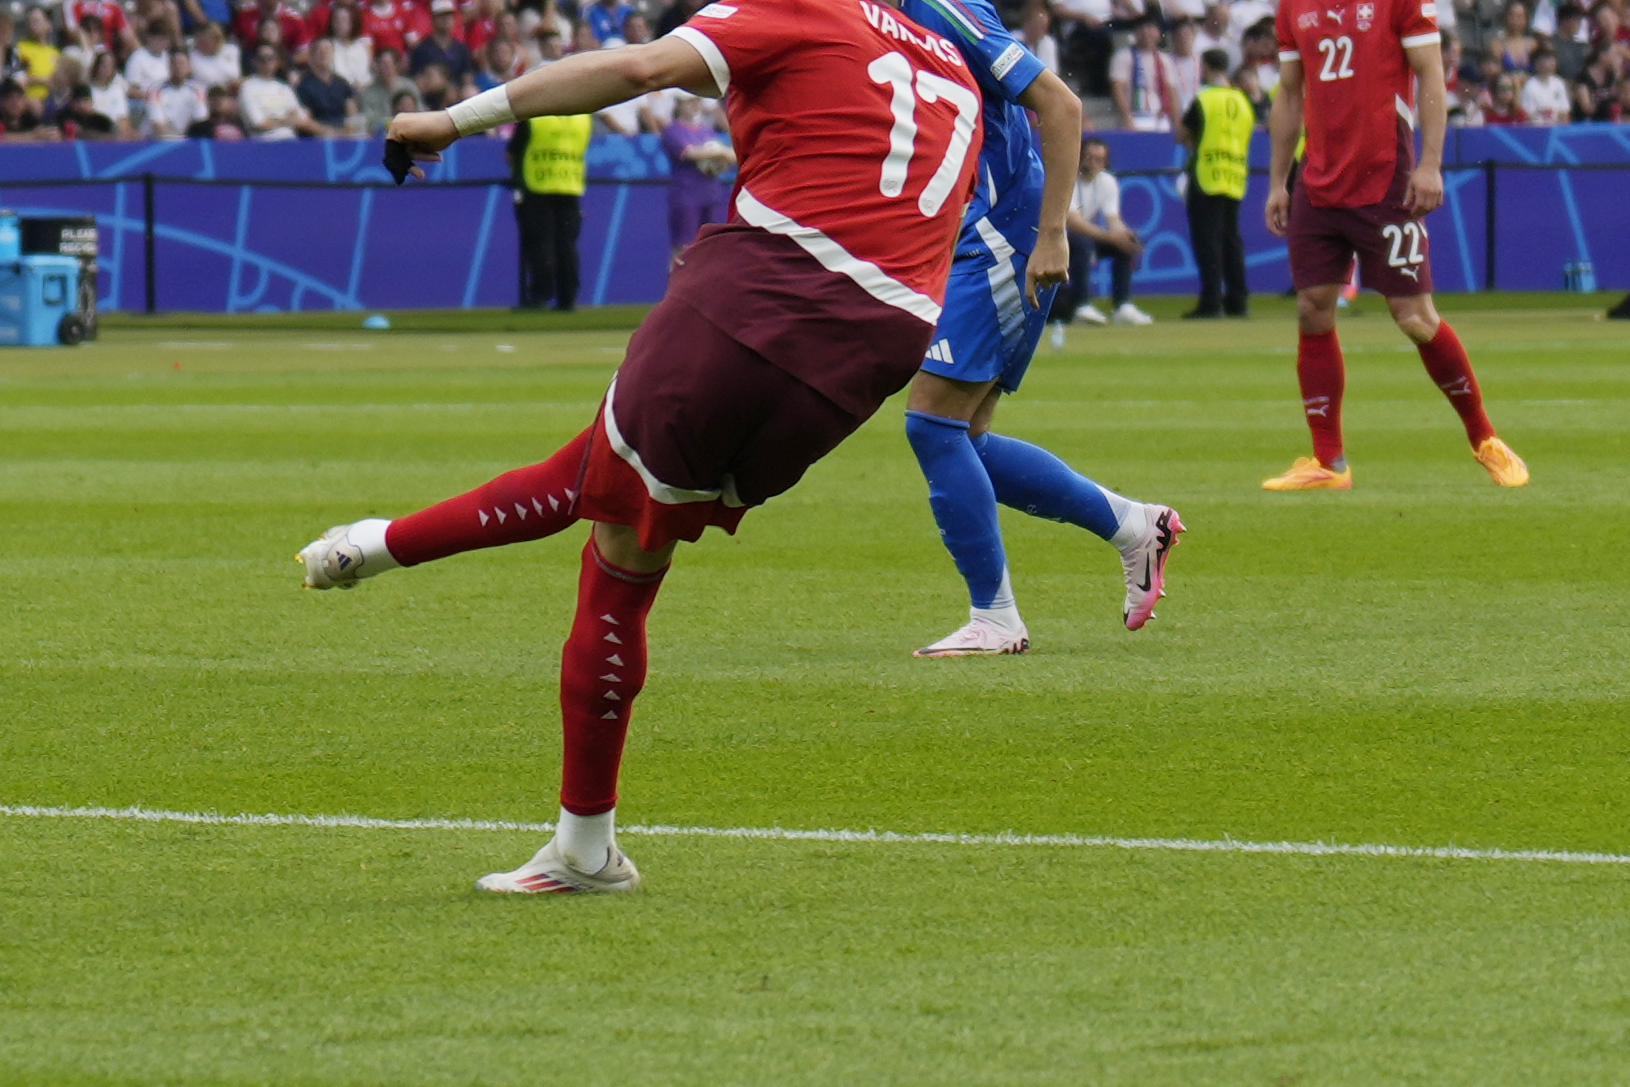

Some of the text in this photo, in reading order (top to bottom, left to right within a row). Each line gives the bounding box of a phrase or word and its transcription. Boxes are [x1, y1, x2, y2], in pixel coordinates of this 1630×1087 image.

[1318, 35, 1355, 82] 22
[867, 50, 979, 218] 17
[1382, 222, 1424, 267] 22
